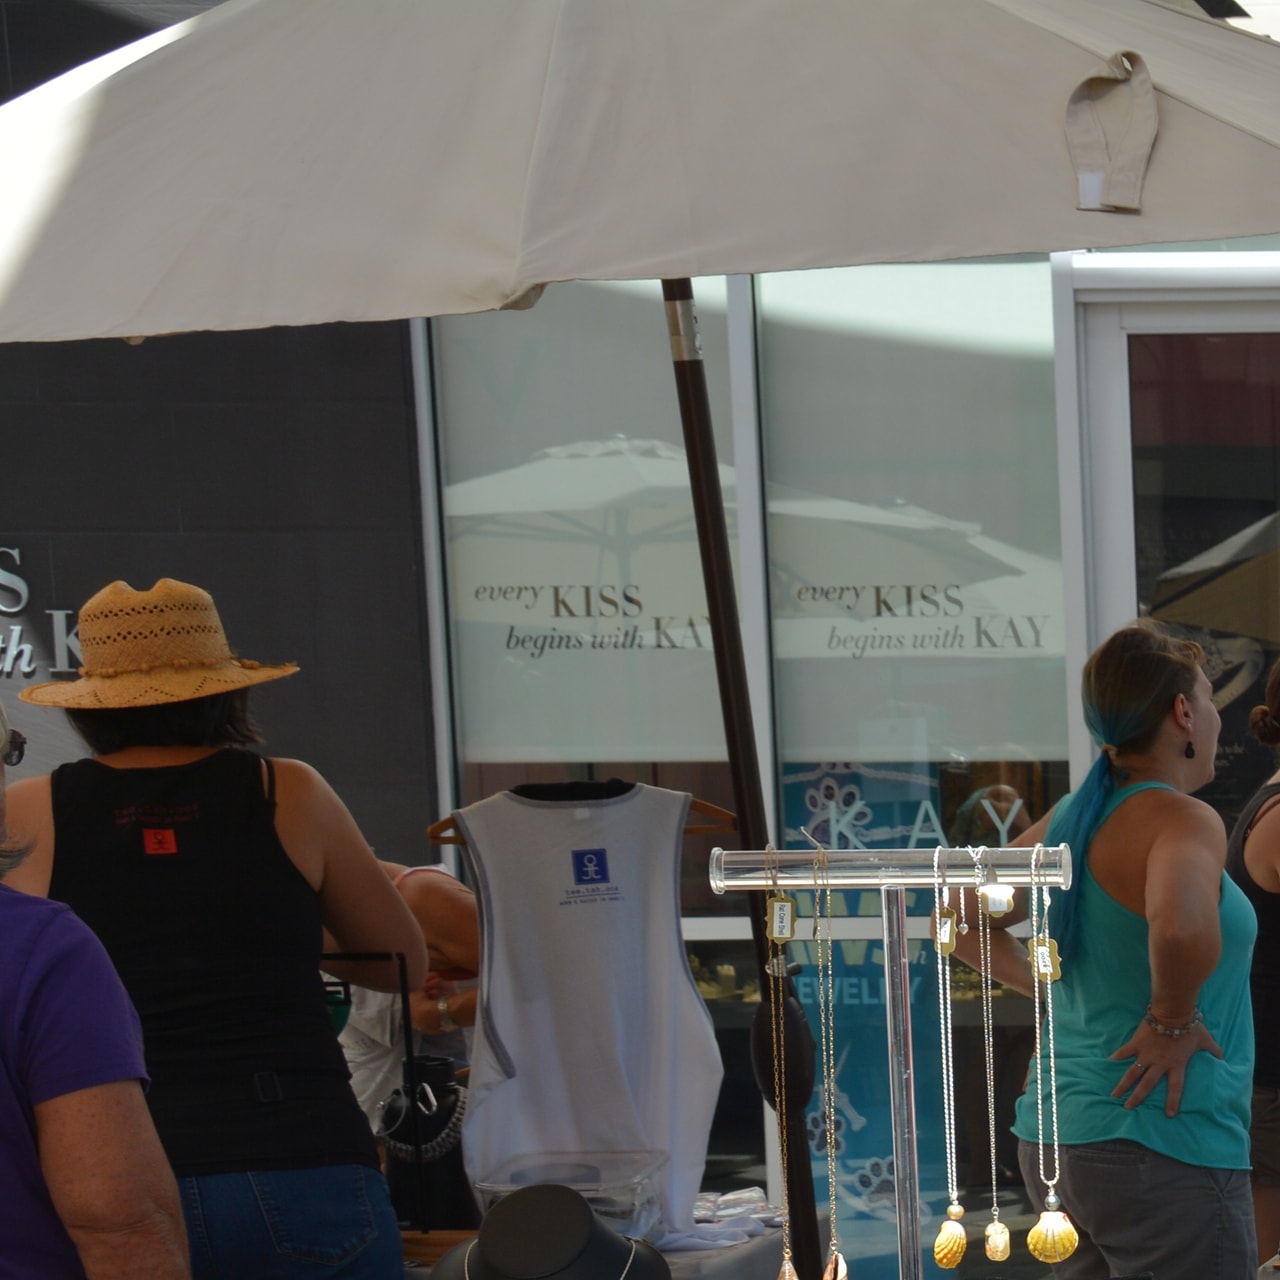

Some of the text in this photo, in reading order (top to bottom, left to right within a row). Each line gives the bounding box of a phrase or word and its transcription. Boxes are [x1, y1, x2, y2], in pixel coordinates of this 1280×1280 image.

[474, 584, 643, 617] every KISS
[797, 584, 964, 617] every KISS
[506, 616, 711, 658] begins with KA
[828, 616, 1050, 659] begins with KAY
